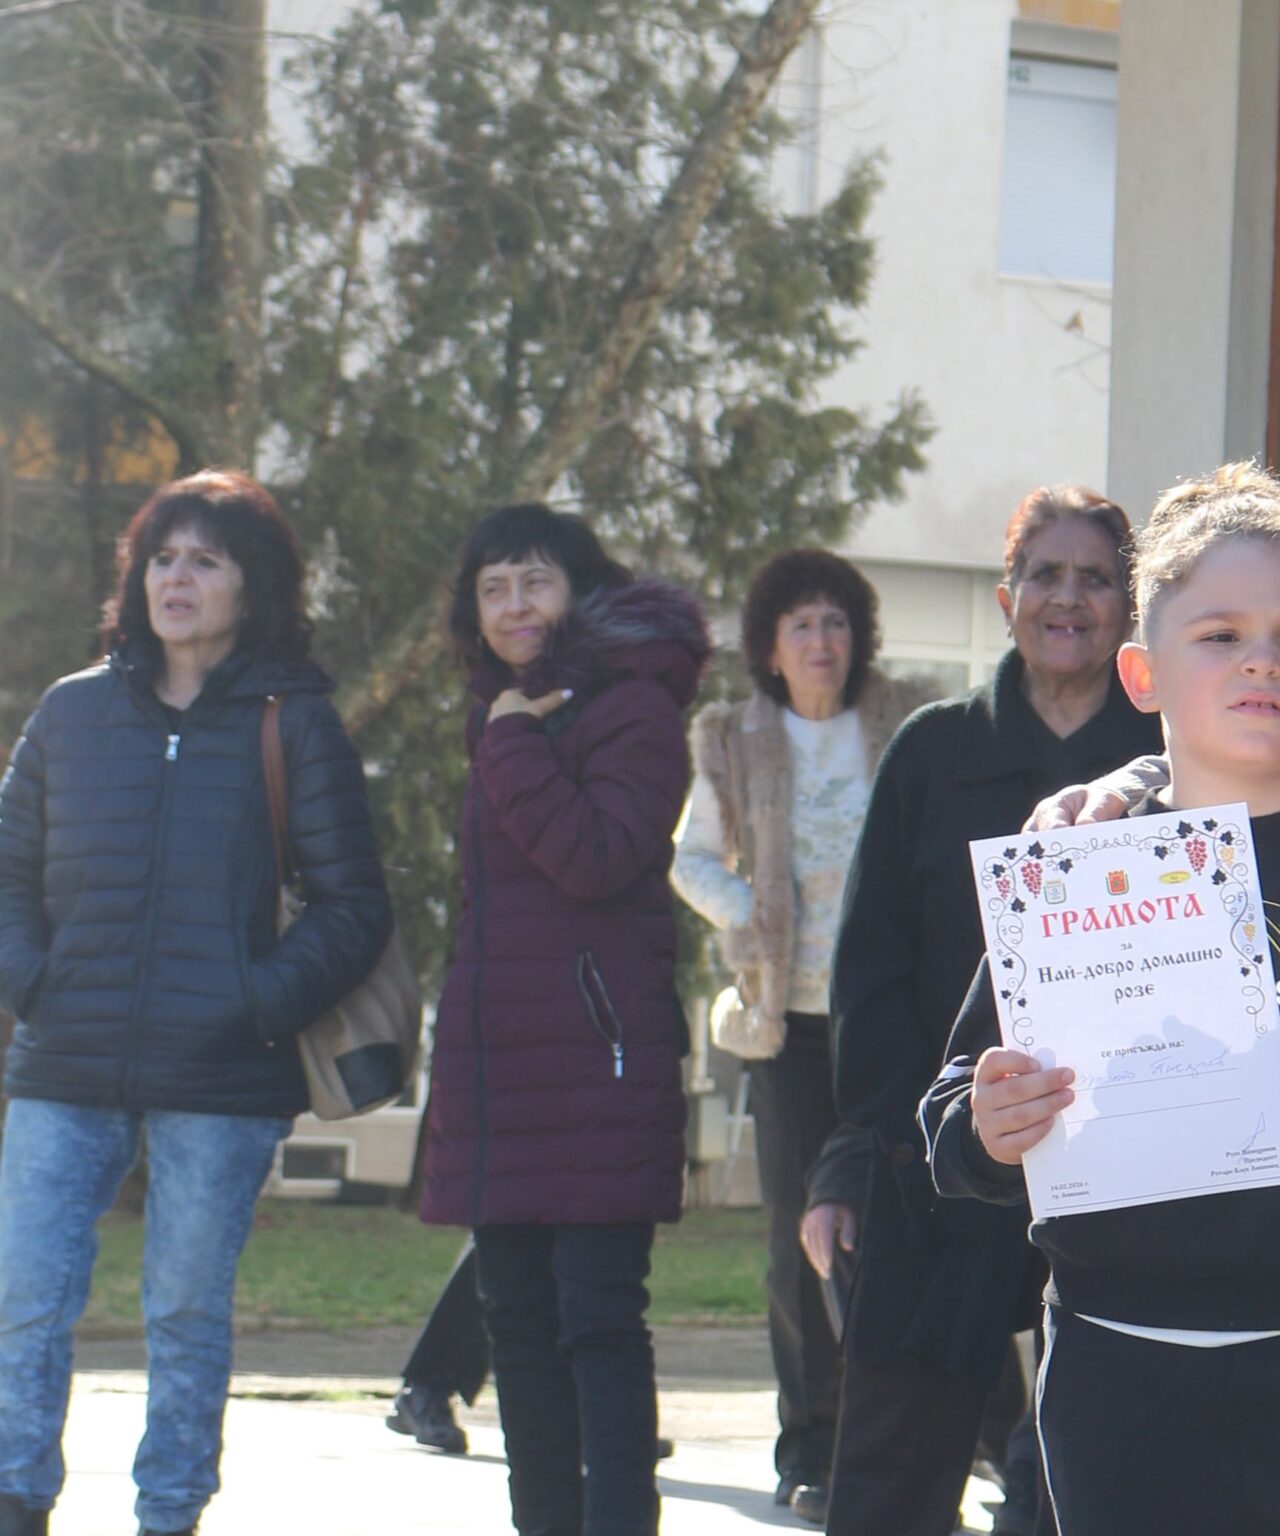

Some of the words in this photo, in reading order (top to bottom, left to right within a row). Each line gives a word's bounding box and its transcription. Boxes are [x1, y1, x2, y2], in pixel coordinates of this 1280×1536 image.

[1040, 893, 1205, 938] ГРАМОТА
[1120, 942, 1133, 951] за
[1037, 960, 1135, 984] Най-добро
[1139, 947, 1223, 972] домашно
[1169, 1040, 1185, 1049] на:
